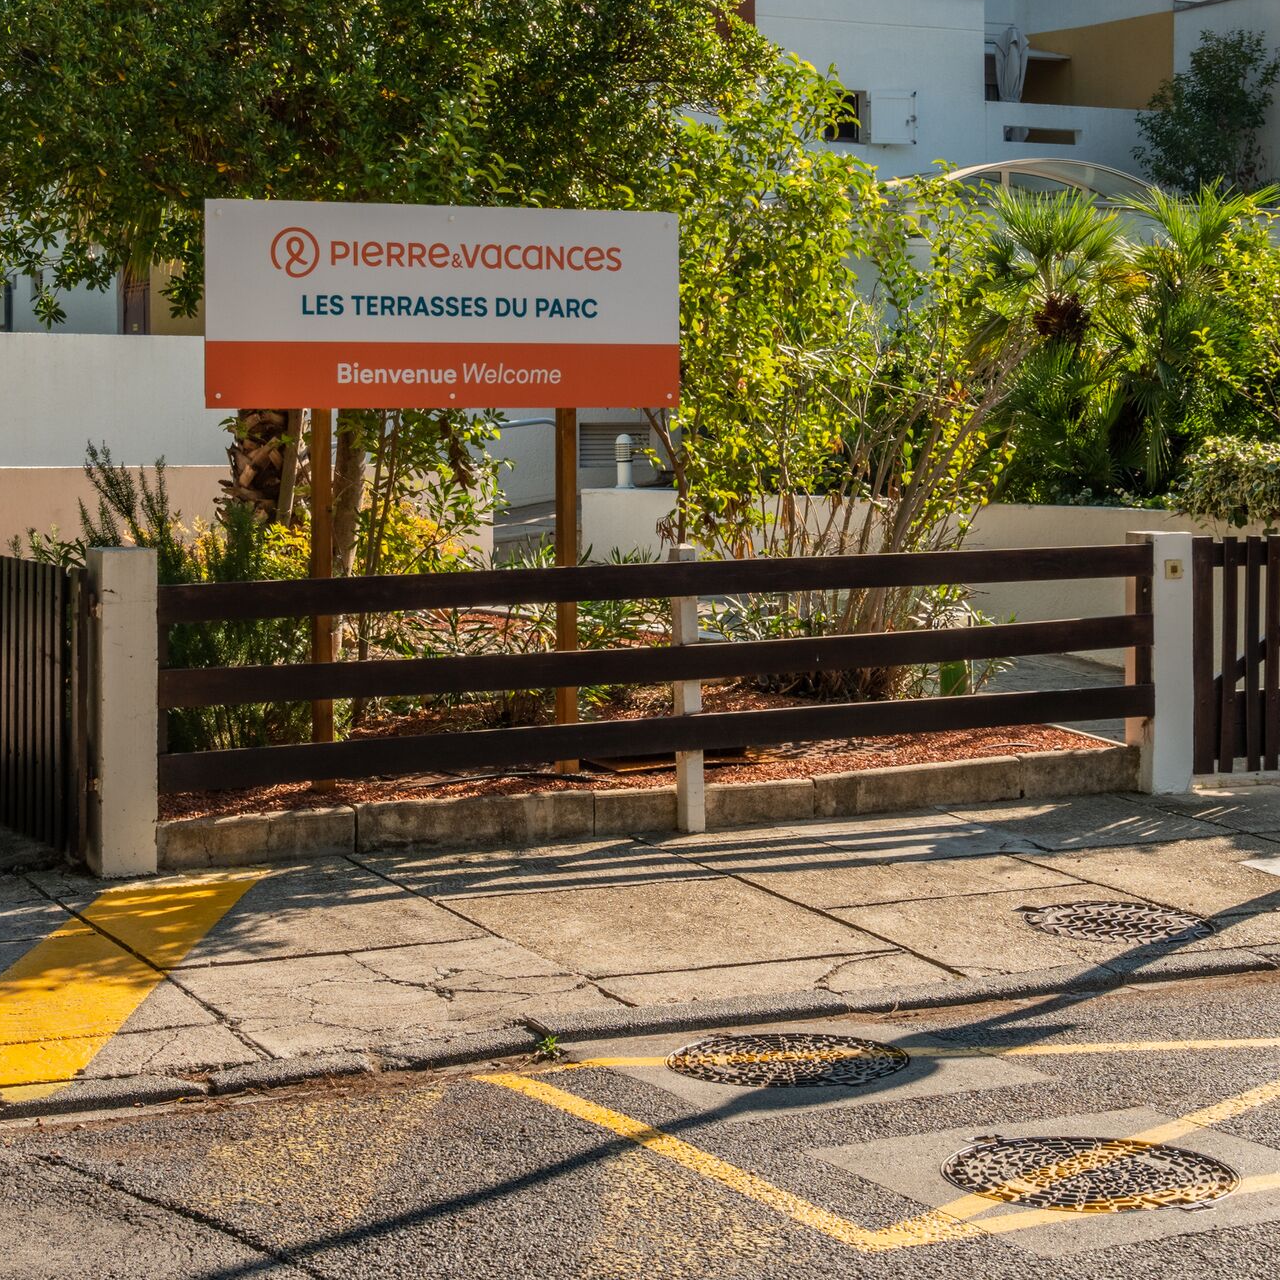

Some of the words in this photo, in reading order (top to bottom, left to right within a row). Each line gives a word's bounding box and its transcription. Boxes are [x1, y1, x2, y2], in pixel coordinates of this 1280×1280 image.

[301, 294, 345, 317] LES
[350, 295, 488, 318] TERRASSES
[495, 297, 528, 319] DU
[535, 297, 599, 320] PARC
[336, 362, 457, 384] Bienvenue
[462, 362, 562, 384] Welcome
